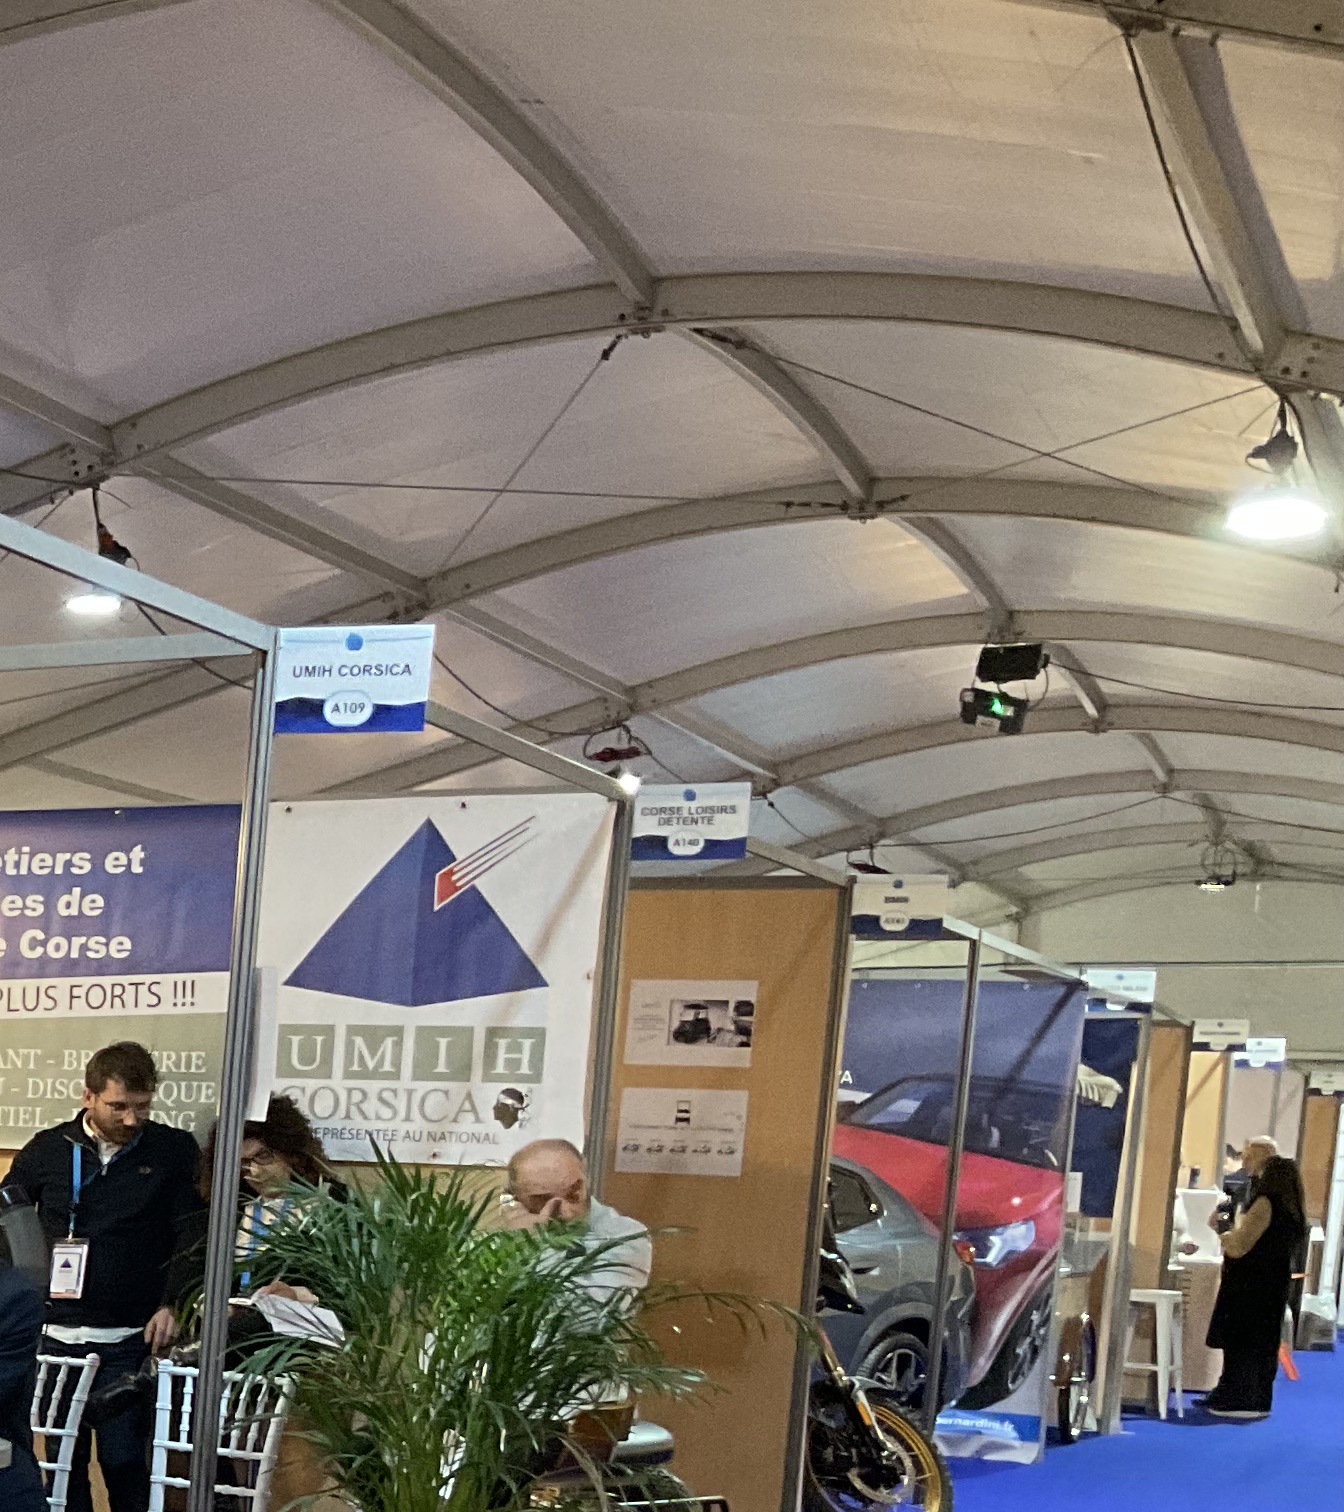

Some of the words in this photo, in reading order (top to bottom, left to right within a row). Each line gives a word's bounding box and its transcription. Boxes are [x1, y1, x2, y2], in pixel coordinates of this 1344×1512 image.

[293, 665, 333, 678] UMIH
[338, 664, 412, 677] CORSICA
[331, 702, 365, 714] A109
[641, 806, 683, 816] CORSE
[688, 804, 736, 815] LOISIRS
[104, 844, 145, 874] et
[57, 886, 105, 917] de
[19, 928, 133, 959] Corse
[69, 981, 162, 1011] FORTS
[172, 979, 196, 1008] !!!
[287, 1035, 537, 1075] UMIH
[402, 1129, 422, 1143] AU
[426, 1130, 500, 1145] NATIONAL
